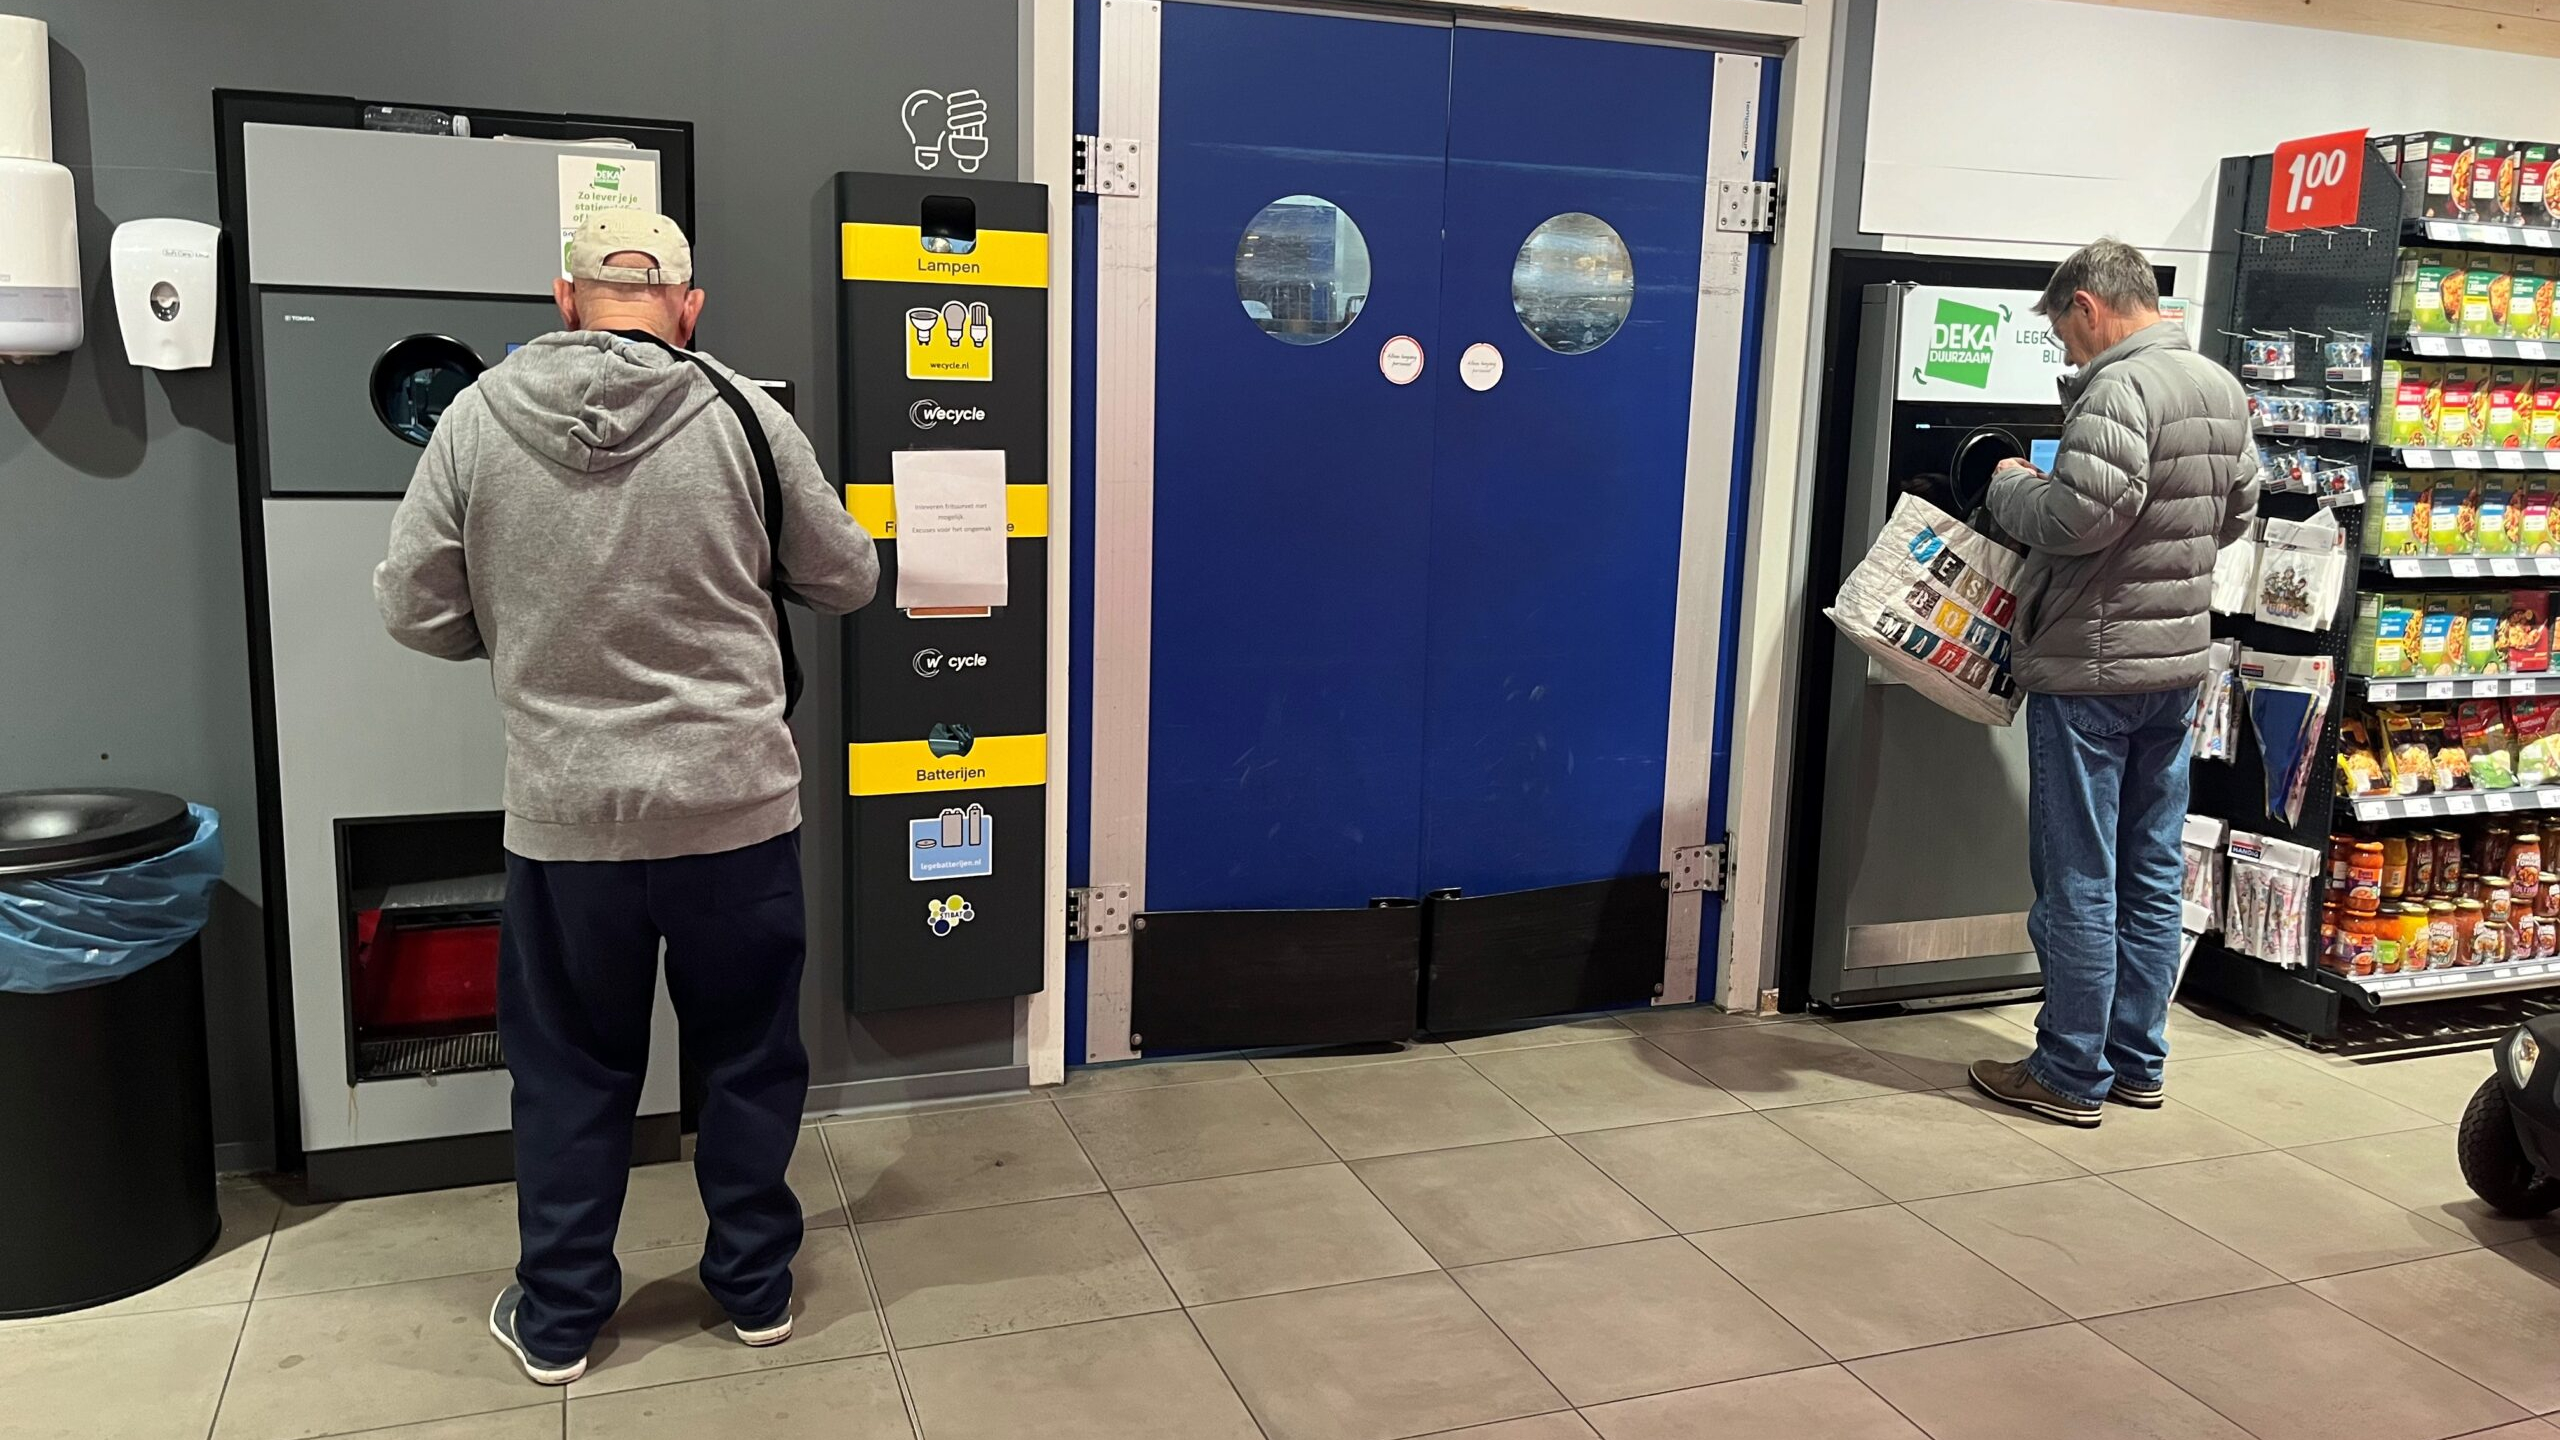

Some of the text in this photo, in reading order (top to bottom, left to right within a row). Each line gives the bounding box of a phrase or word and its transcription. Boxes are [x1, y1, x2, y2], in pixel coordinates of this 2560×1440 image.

[596, 170, 620, 180] DEKA
[2286, 149, 2346, 213] 1.00
[578, 192, 638, 204] Zo lever je je
[918, 259, 980, 276] Lampen
[1930, 323, 1996, 350] DEKA
[2016, 330, 2047, 344] LEGE
[1929, 349, 1991, 364] DUURZAAM
[930, 361, 970, 370] wecycle.nl
[916, 766, 986, 782] Batterijen
[920, 858, 982, 870] legebatterijen.nl
